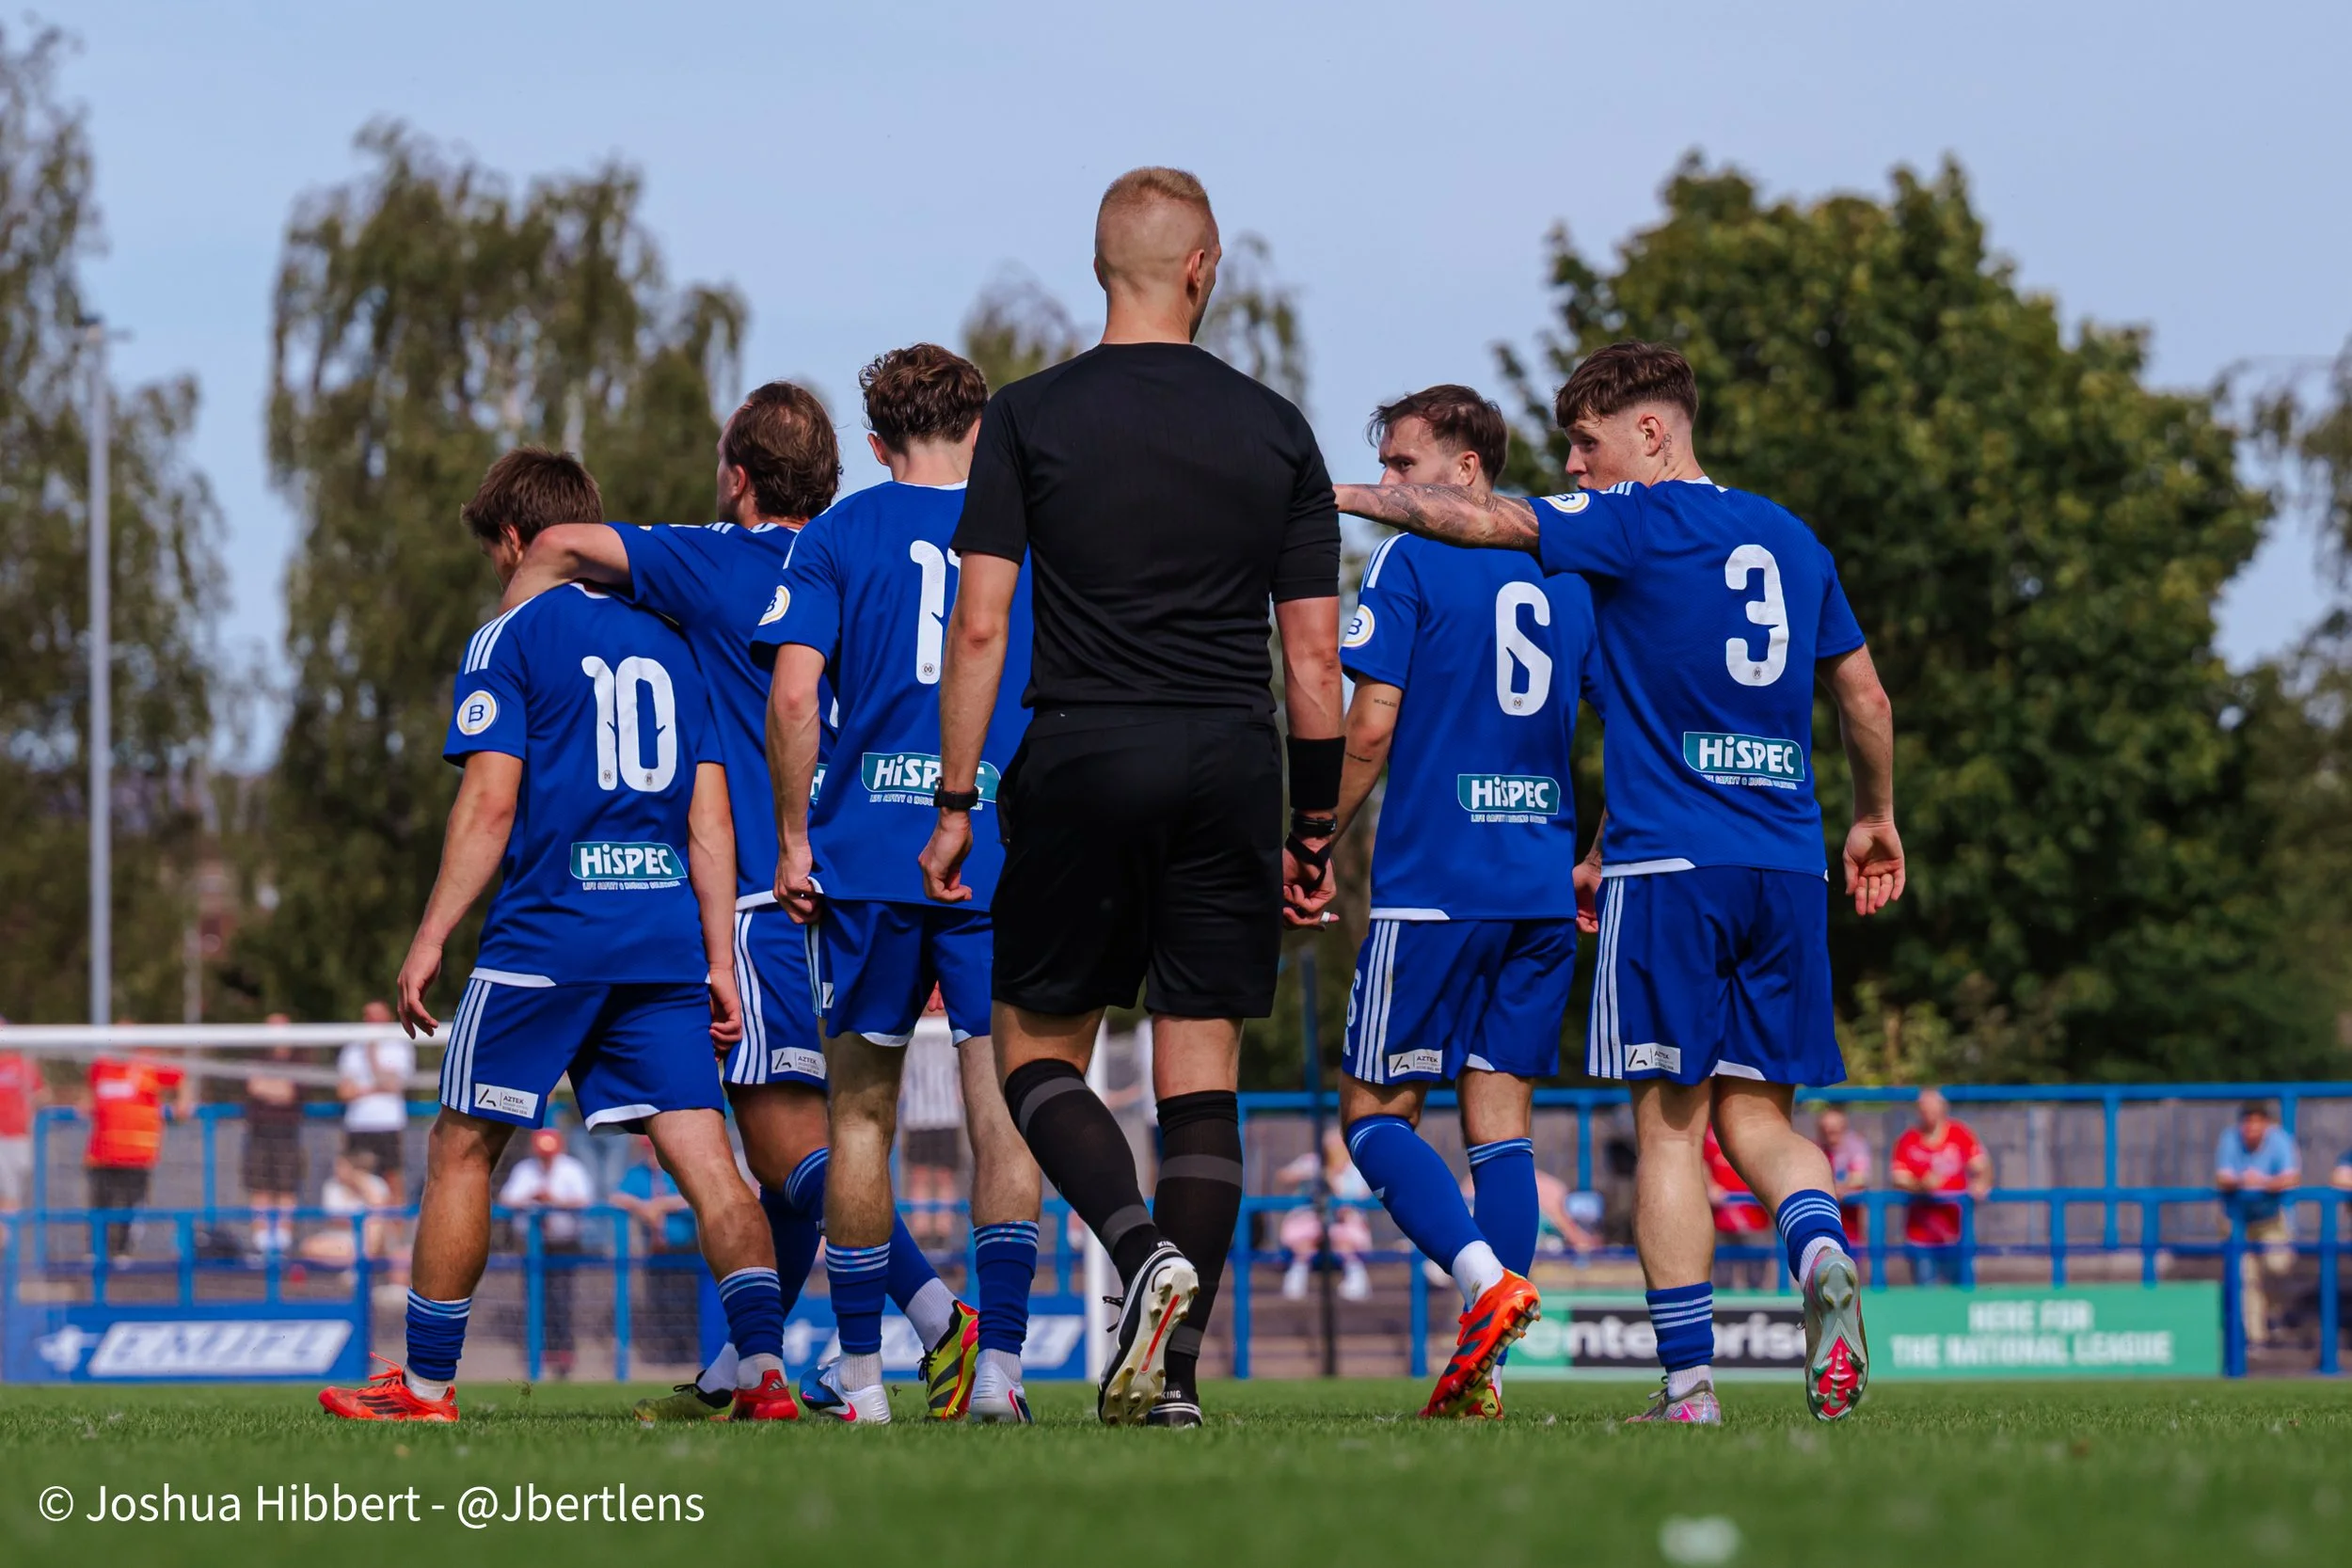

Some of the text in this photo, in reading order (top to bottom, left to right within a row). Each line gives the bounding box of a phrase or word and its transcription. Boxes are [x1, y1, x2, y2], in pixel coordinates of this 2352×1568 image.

[910, 540, 961, 684] 1
[1725, 544, 1788, 686] 3
[1496, 581, 1552, 716] 6
[469, 704, 485, 723] B
[581, 656, 677, 792] 10
[873, 754, 985, 795] HiSP
[798, 1055, 817, 1065] AZTEK
[503, 1095, 524, 1104] AZTEK
[1968, 1300, 2092, 1330] HERE FOR
[1892, 1332, 2173, 1367] THE NATIONAL LEAGUE
